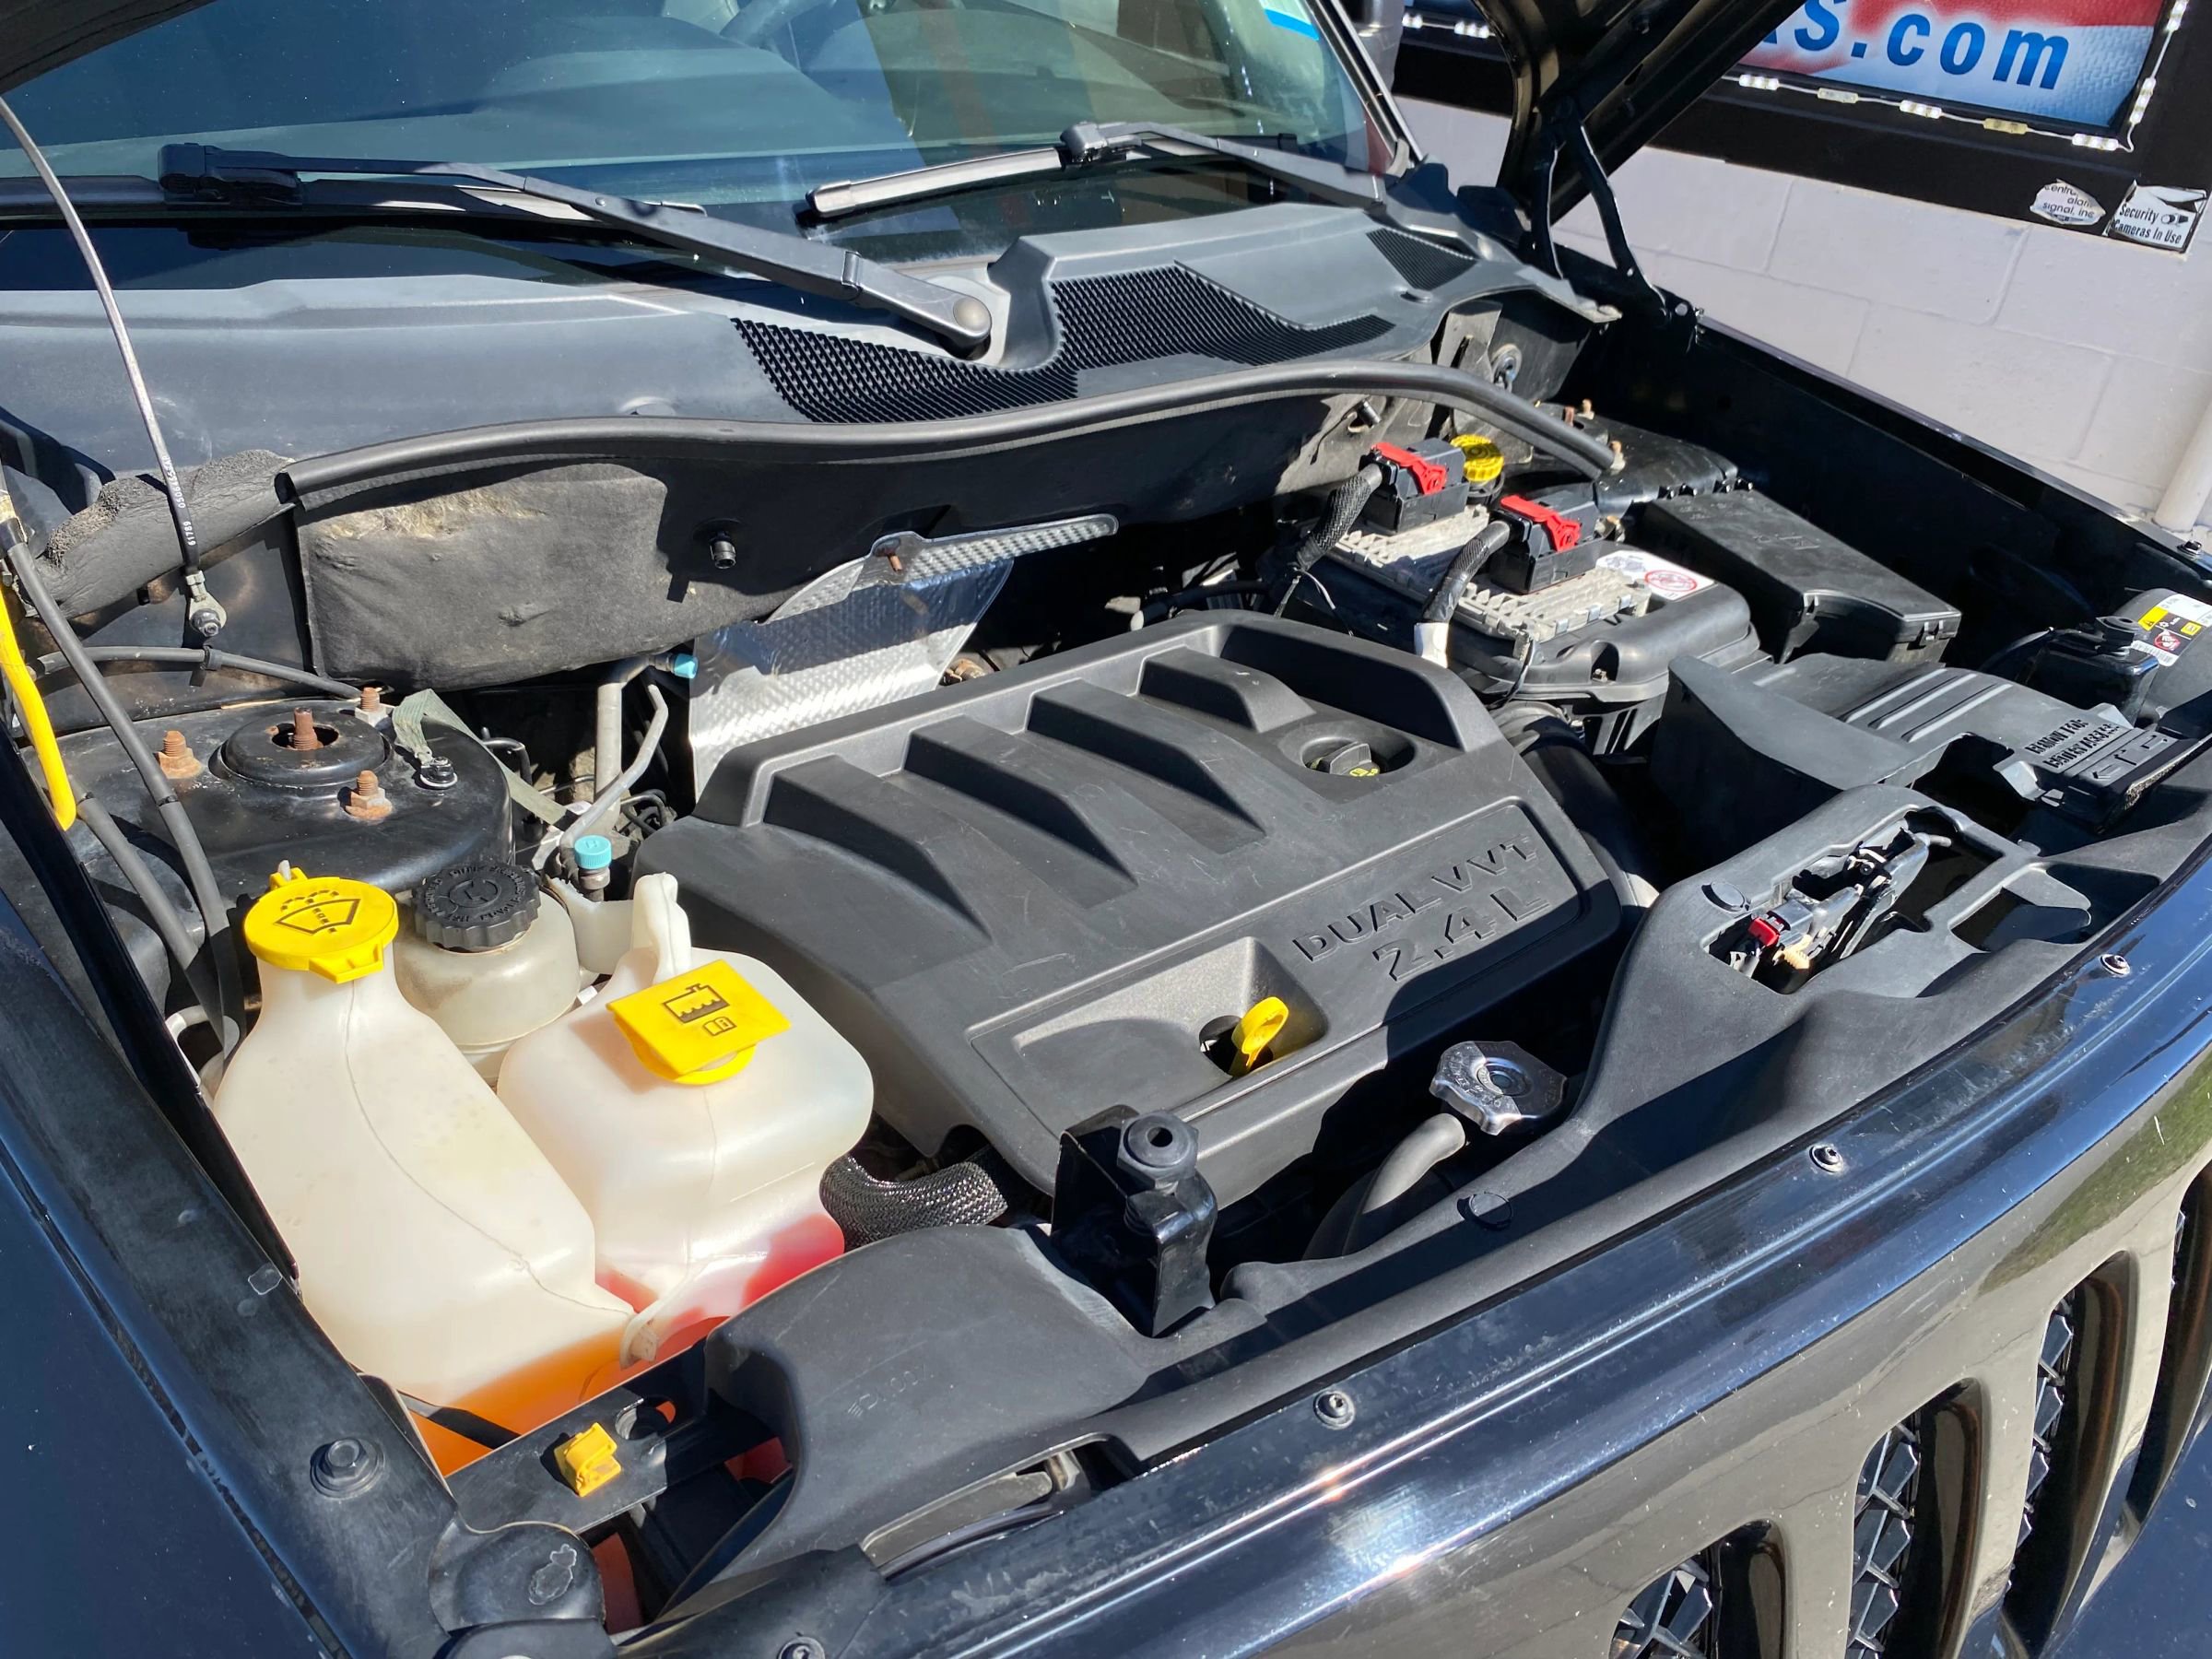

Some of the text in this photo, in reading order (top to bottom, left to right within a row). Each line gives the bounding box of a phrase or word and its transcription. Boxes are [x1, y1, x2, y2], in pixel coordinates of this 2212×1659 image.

[1763, 0, 2070, 90] S.com
[2113, 218, 2182, 244] Cameras In Use
[2120, 203, 2159, 225] Security
[182, 521, 196, 546] 61789
[1292, 836, 1537, 962] DUAL VVT
[1372, 886, 1550, 982] 2.4L
